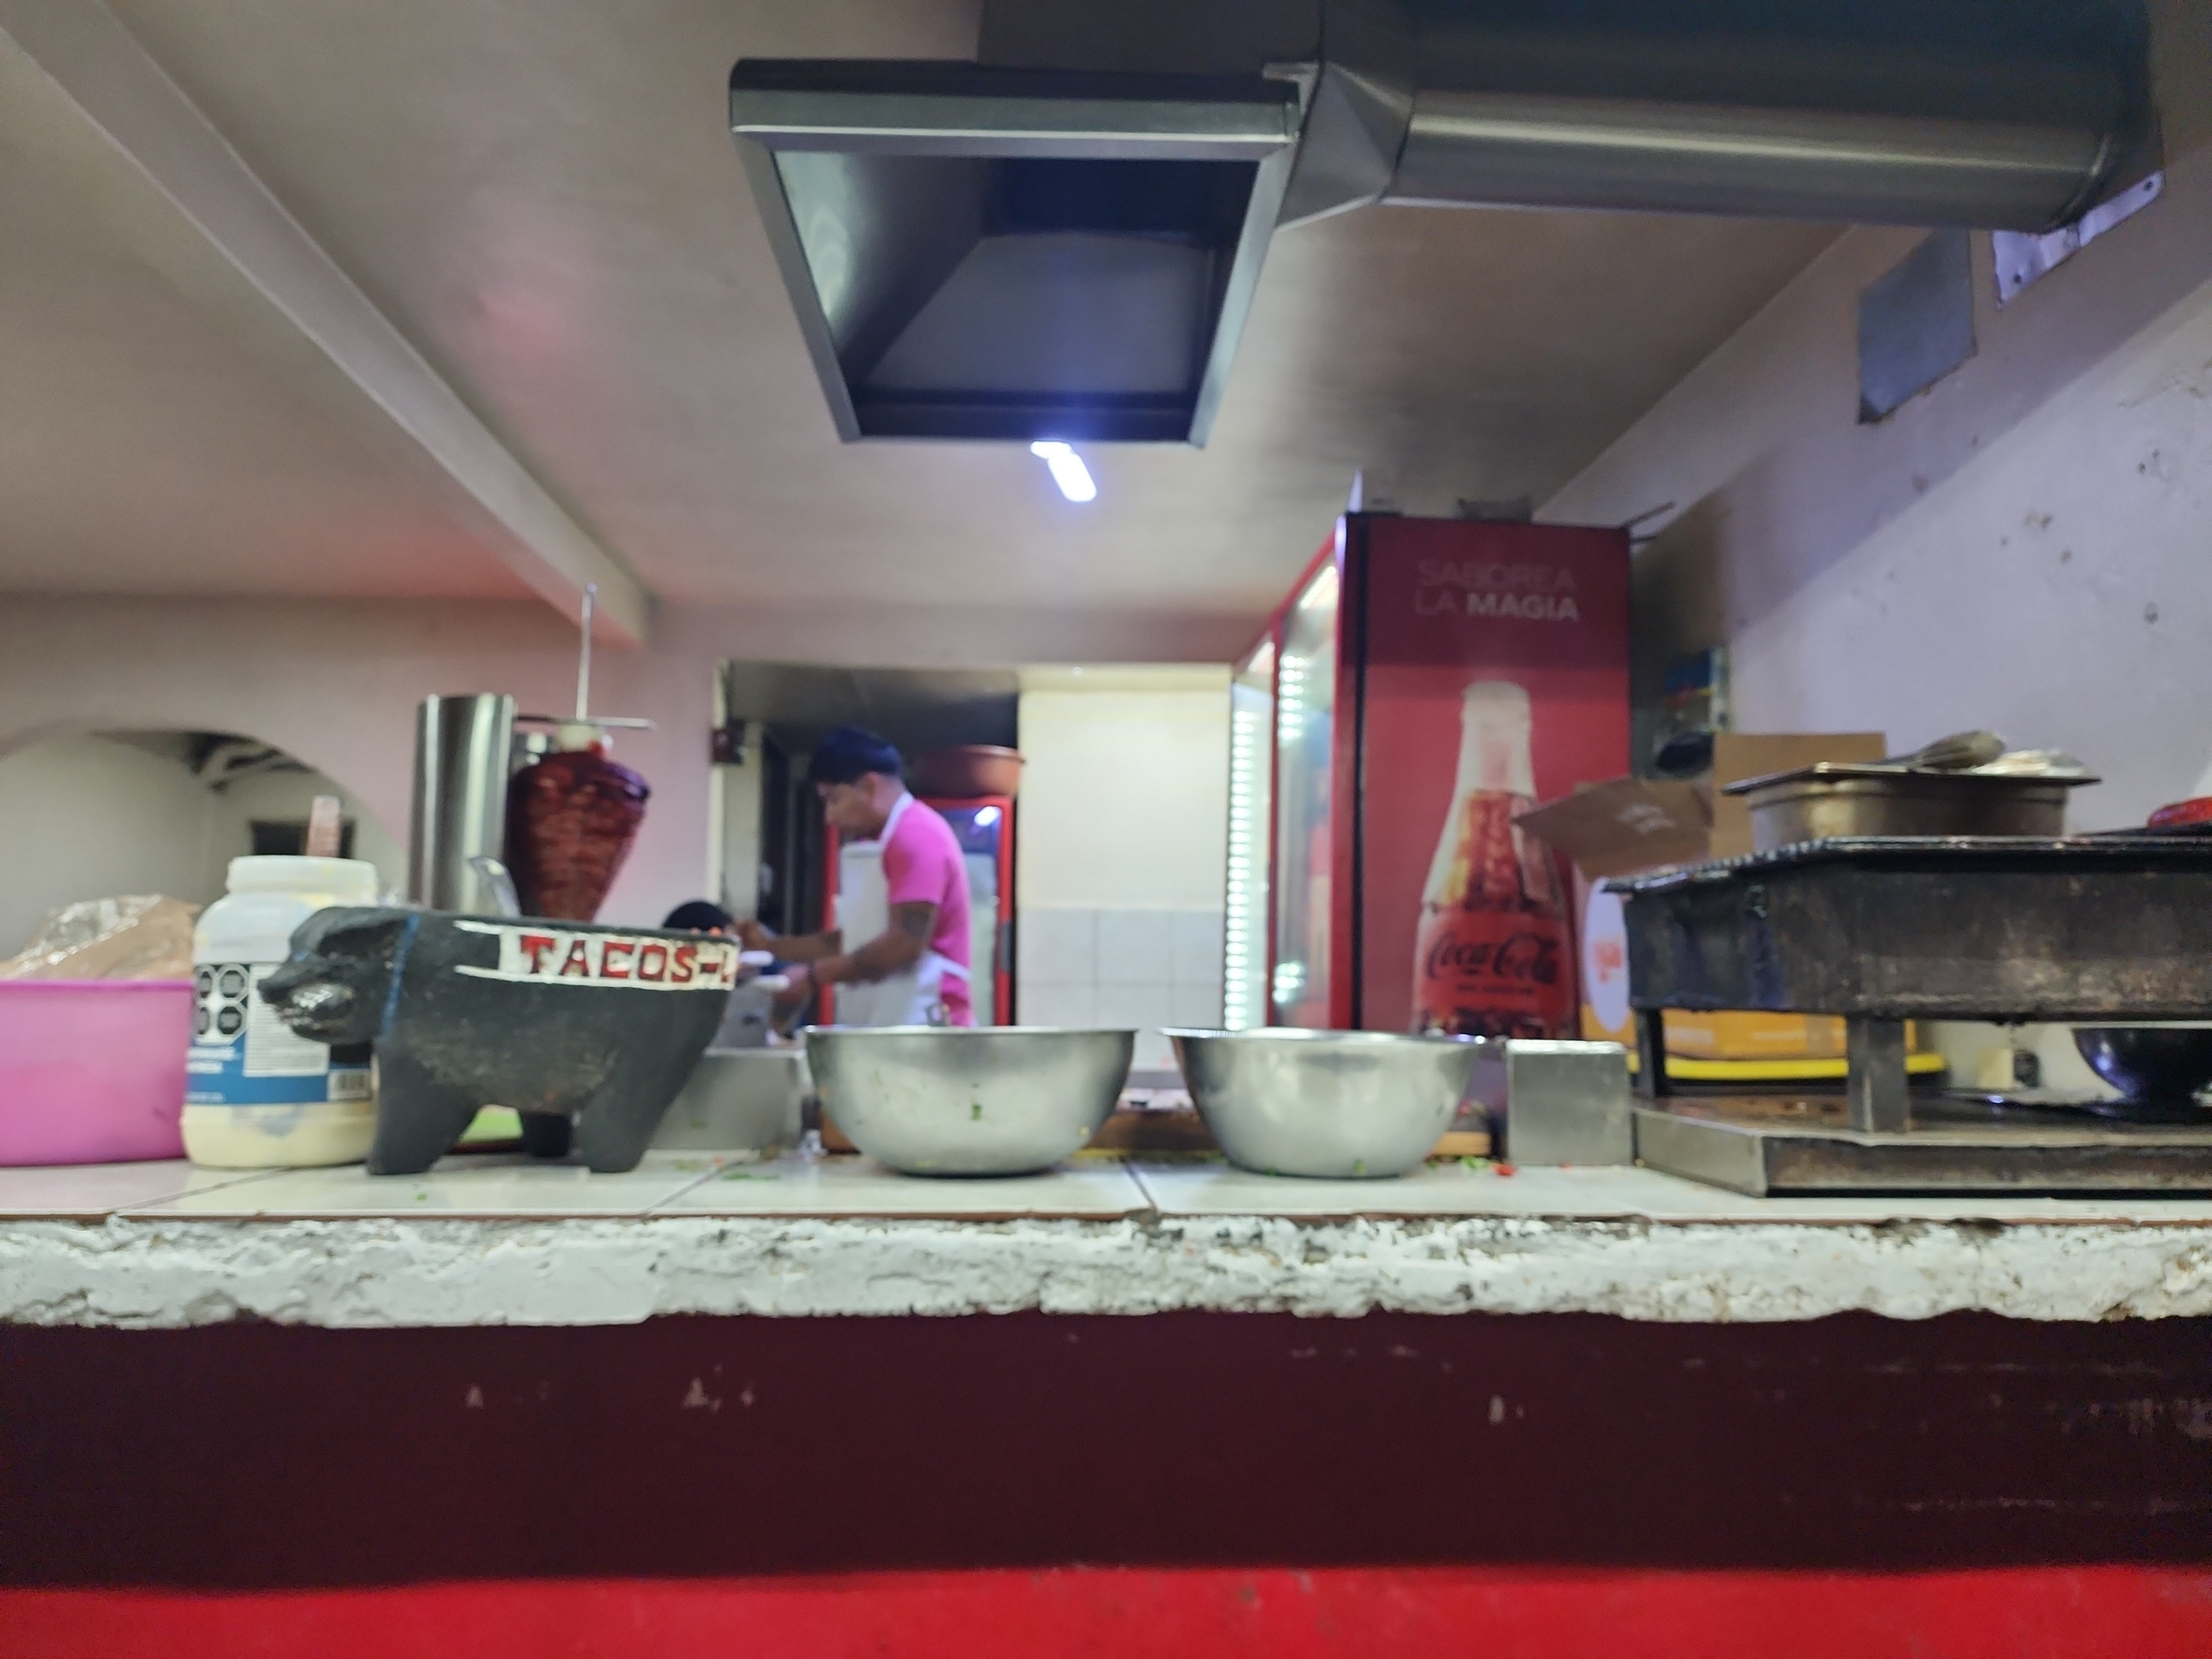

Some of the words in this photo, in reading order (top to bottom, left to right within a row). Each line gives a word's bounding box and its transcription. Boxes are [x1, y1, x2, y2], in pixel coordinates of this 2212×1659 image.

[1417, 560, 1577, 592] SABOREA
[1415, 589, 1458, 615] LA
[1467, 592, 1580, 622] MAGIA
